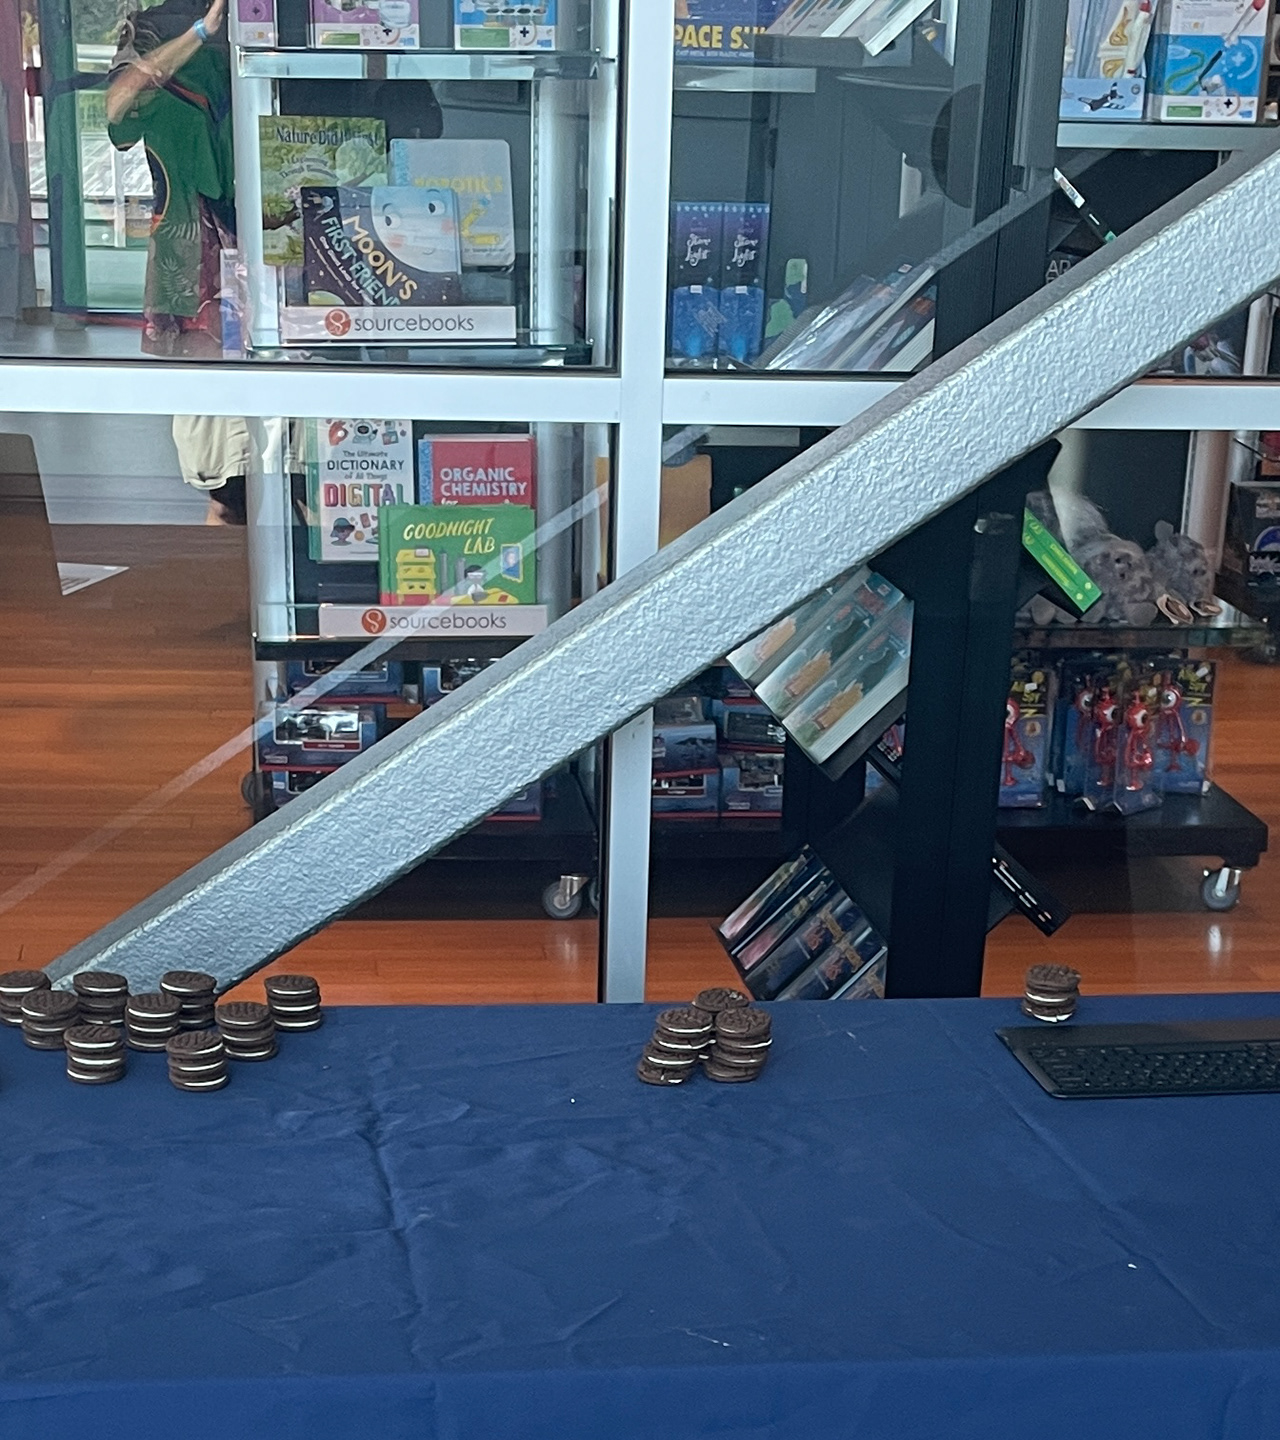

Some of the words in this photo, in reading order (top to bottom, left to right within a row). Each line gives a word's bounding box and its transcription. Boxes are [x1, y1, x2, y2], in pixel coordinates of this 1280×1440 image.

[276, 125, 317, 144] Nature
[321, 216, 358, 260] FIRST
[341, 215, 418, 300] MOON'S
[354, 314, 475, 332] sourcebooks
[326, 459, 405, 471] DICTIONARY
[440, 467, 515, 482] ORGANIC
[323, 483, 408, 508] DIGITAL
[440, 482, 528, 497] CHEMISTRY
[403, 517, 496, 541] GOODNIGHT
[463, 537, 496, 555] LAB
[389, 613, 508, 630] sourcebooks
